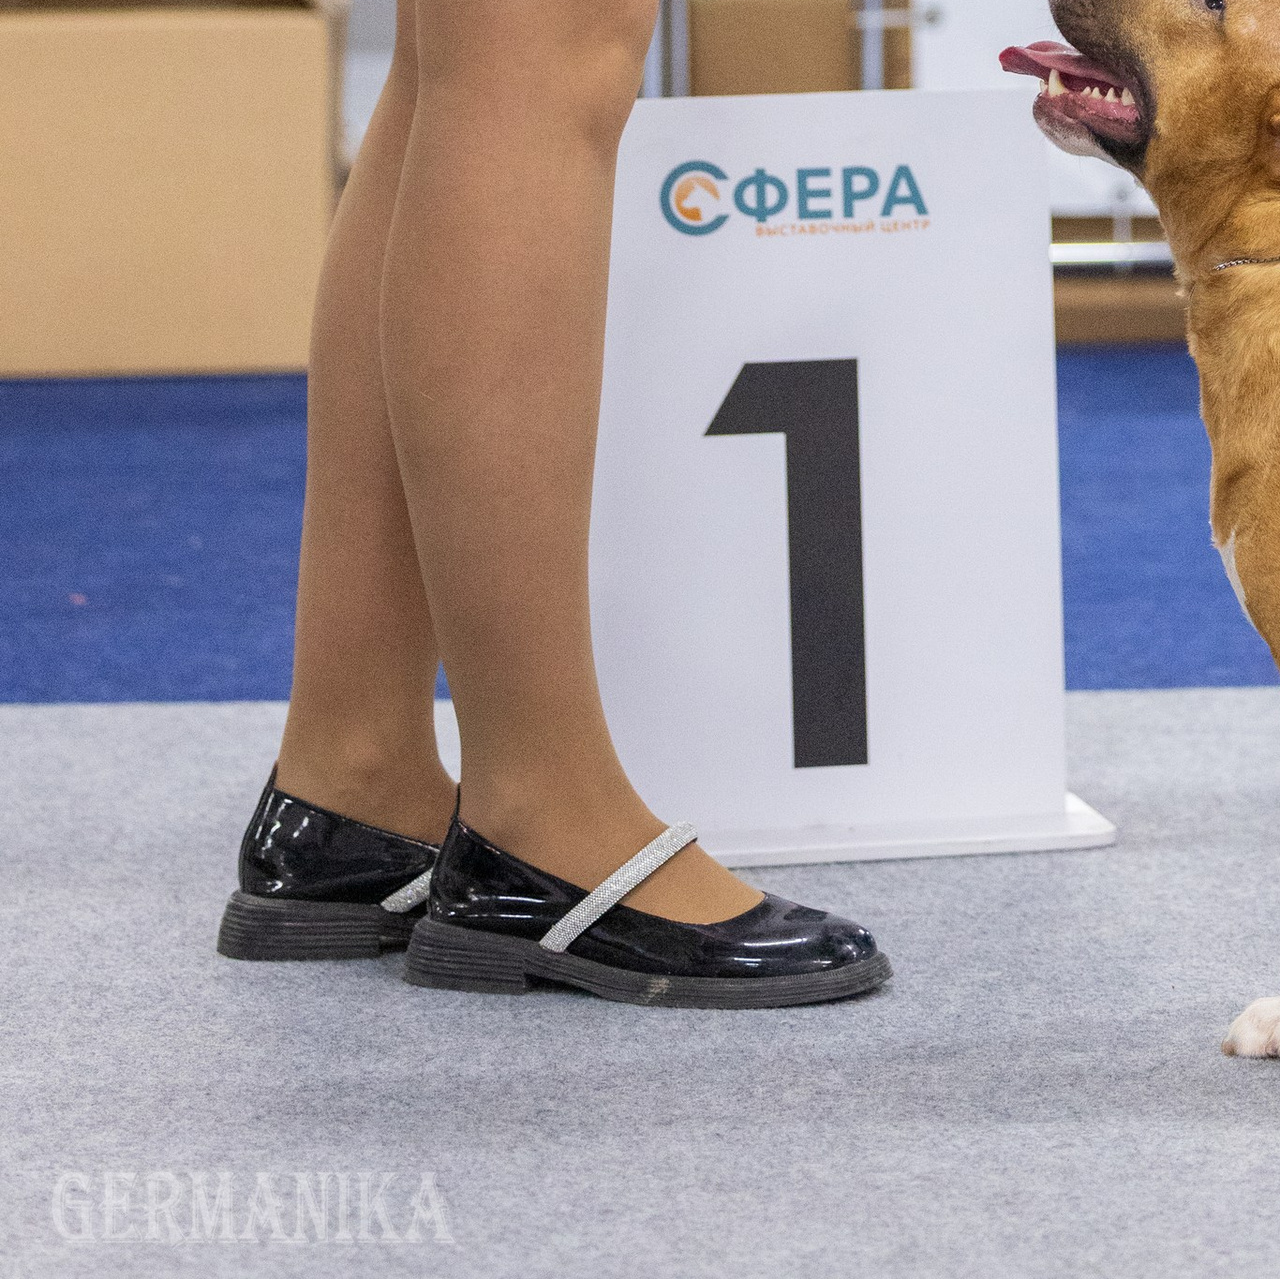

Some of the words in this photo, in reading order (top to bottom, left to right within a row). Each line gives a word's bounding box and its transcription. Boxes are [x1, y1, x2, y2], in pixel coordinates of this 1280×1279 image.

[660, 160, 928, 236] СФЕРА
[755, 219, 876, 237] ВЫСТАВОЧНЫЙ
[879, 218, 931, 234] ЦЕНТР
[703, 357, 869, 768] 1
